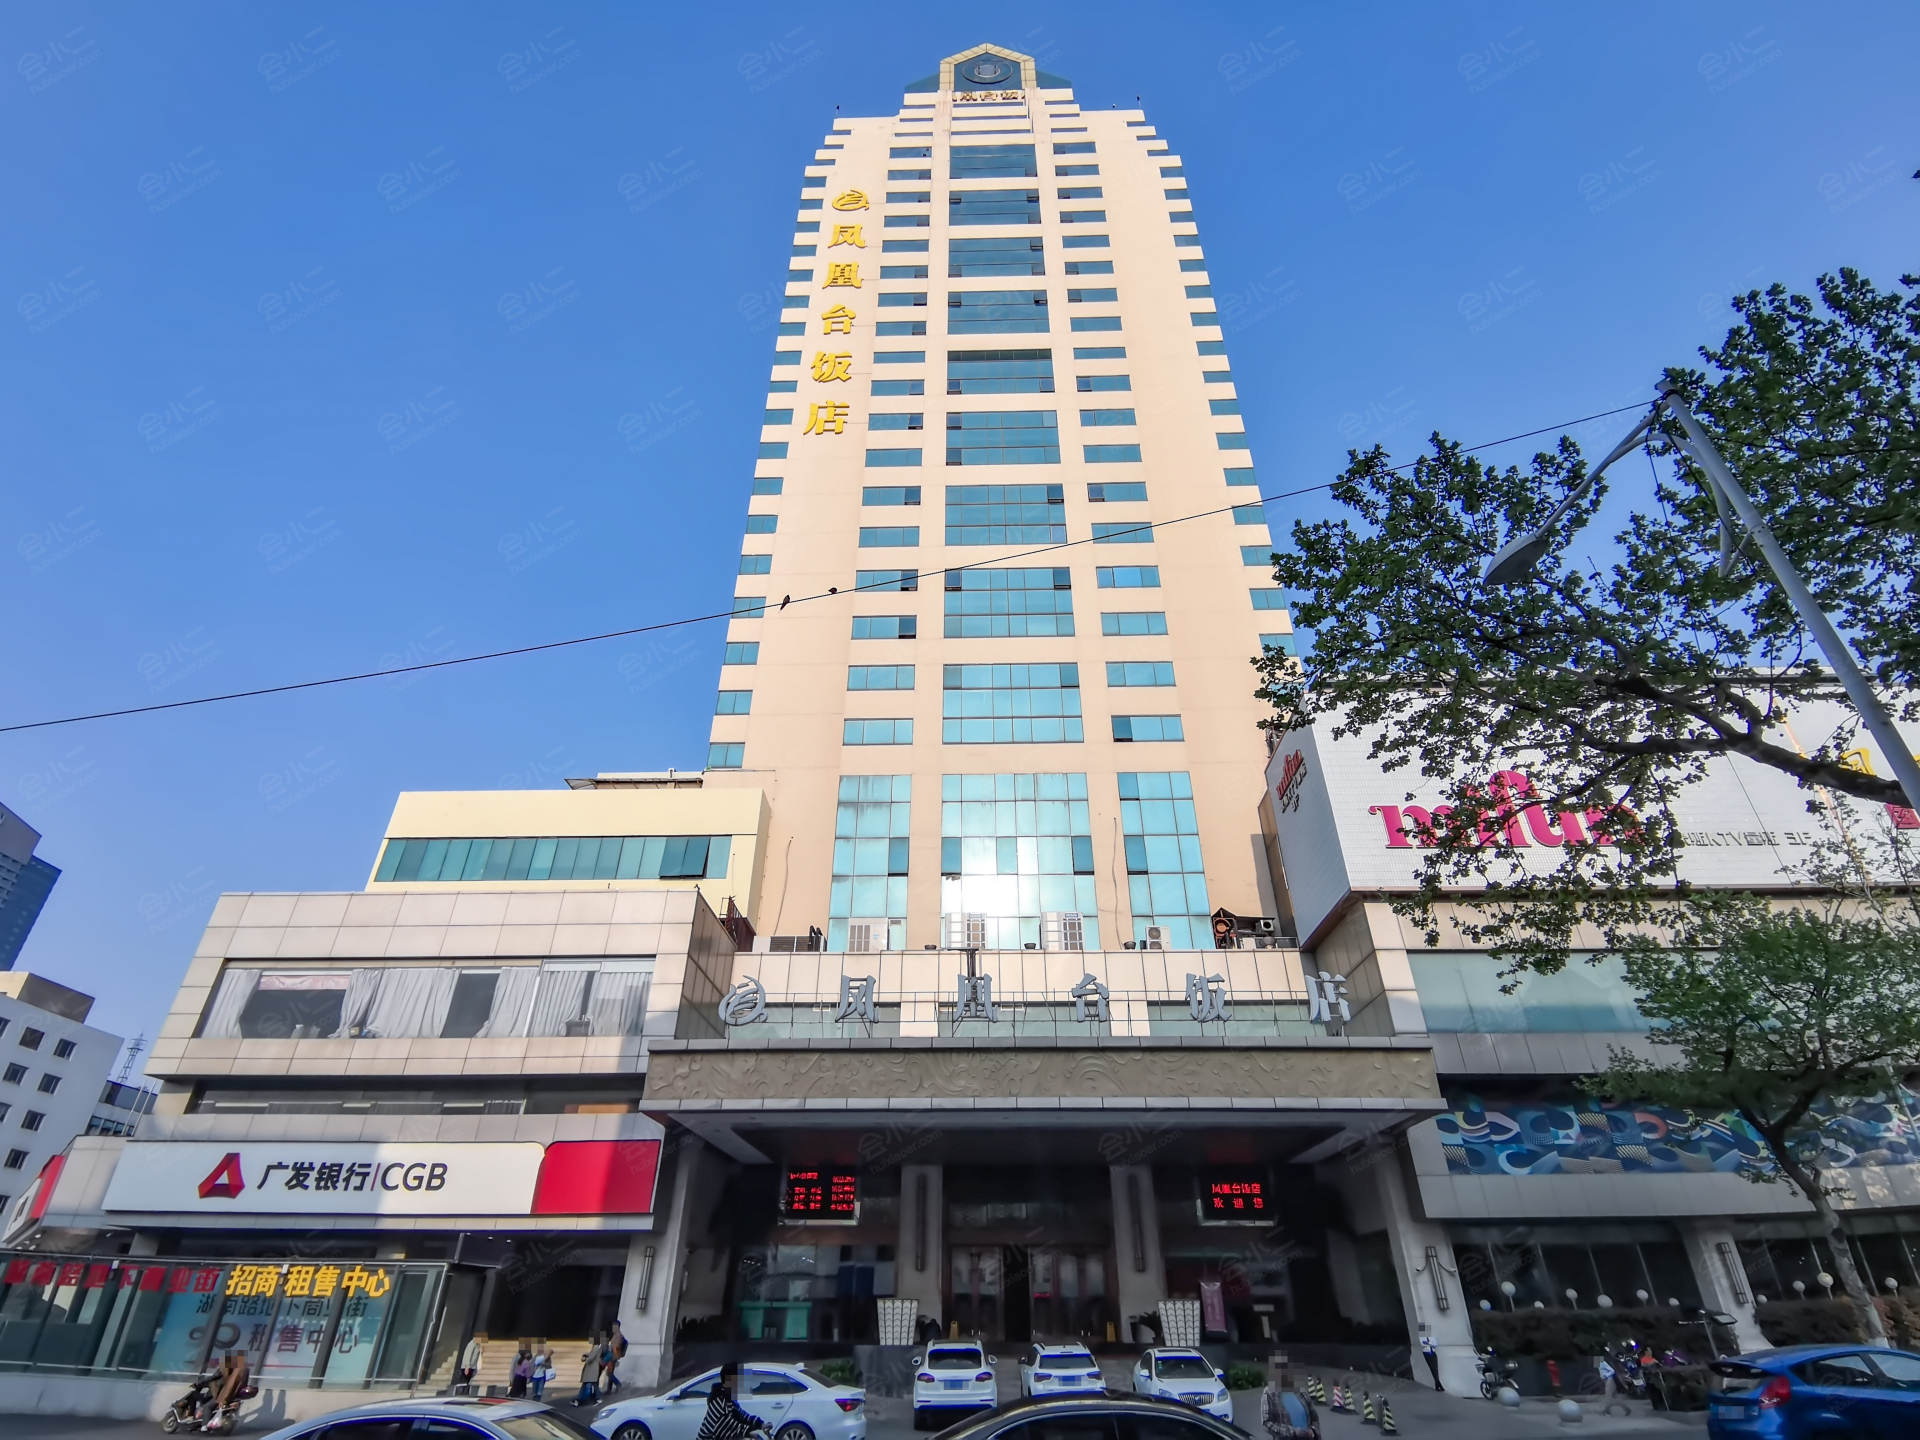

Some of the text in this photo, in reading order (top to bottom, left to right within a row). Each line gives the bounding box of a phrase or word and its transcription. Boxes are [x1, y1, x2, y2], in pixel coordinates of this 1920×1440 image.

[802, 222, 867, 436] 凤凰台饭店
[835, 971, 1351, 1026] 凤凰台饭店
[256, 1161, 448, 1192] 广发银行 CGB
[1211, 1183, 1261, 1194] 凤凰台饭店
